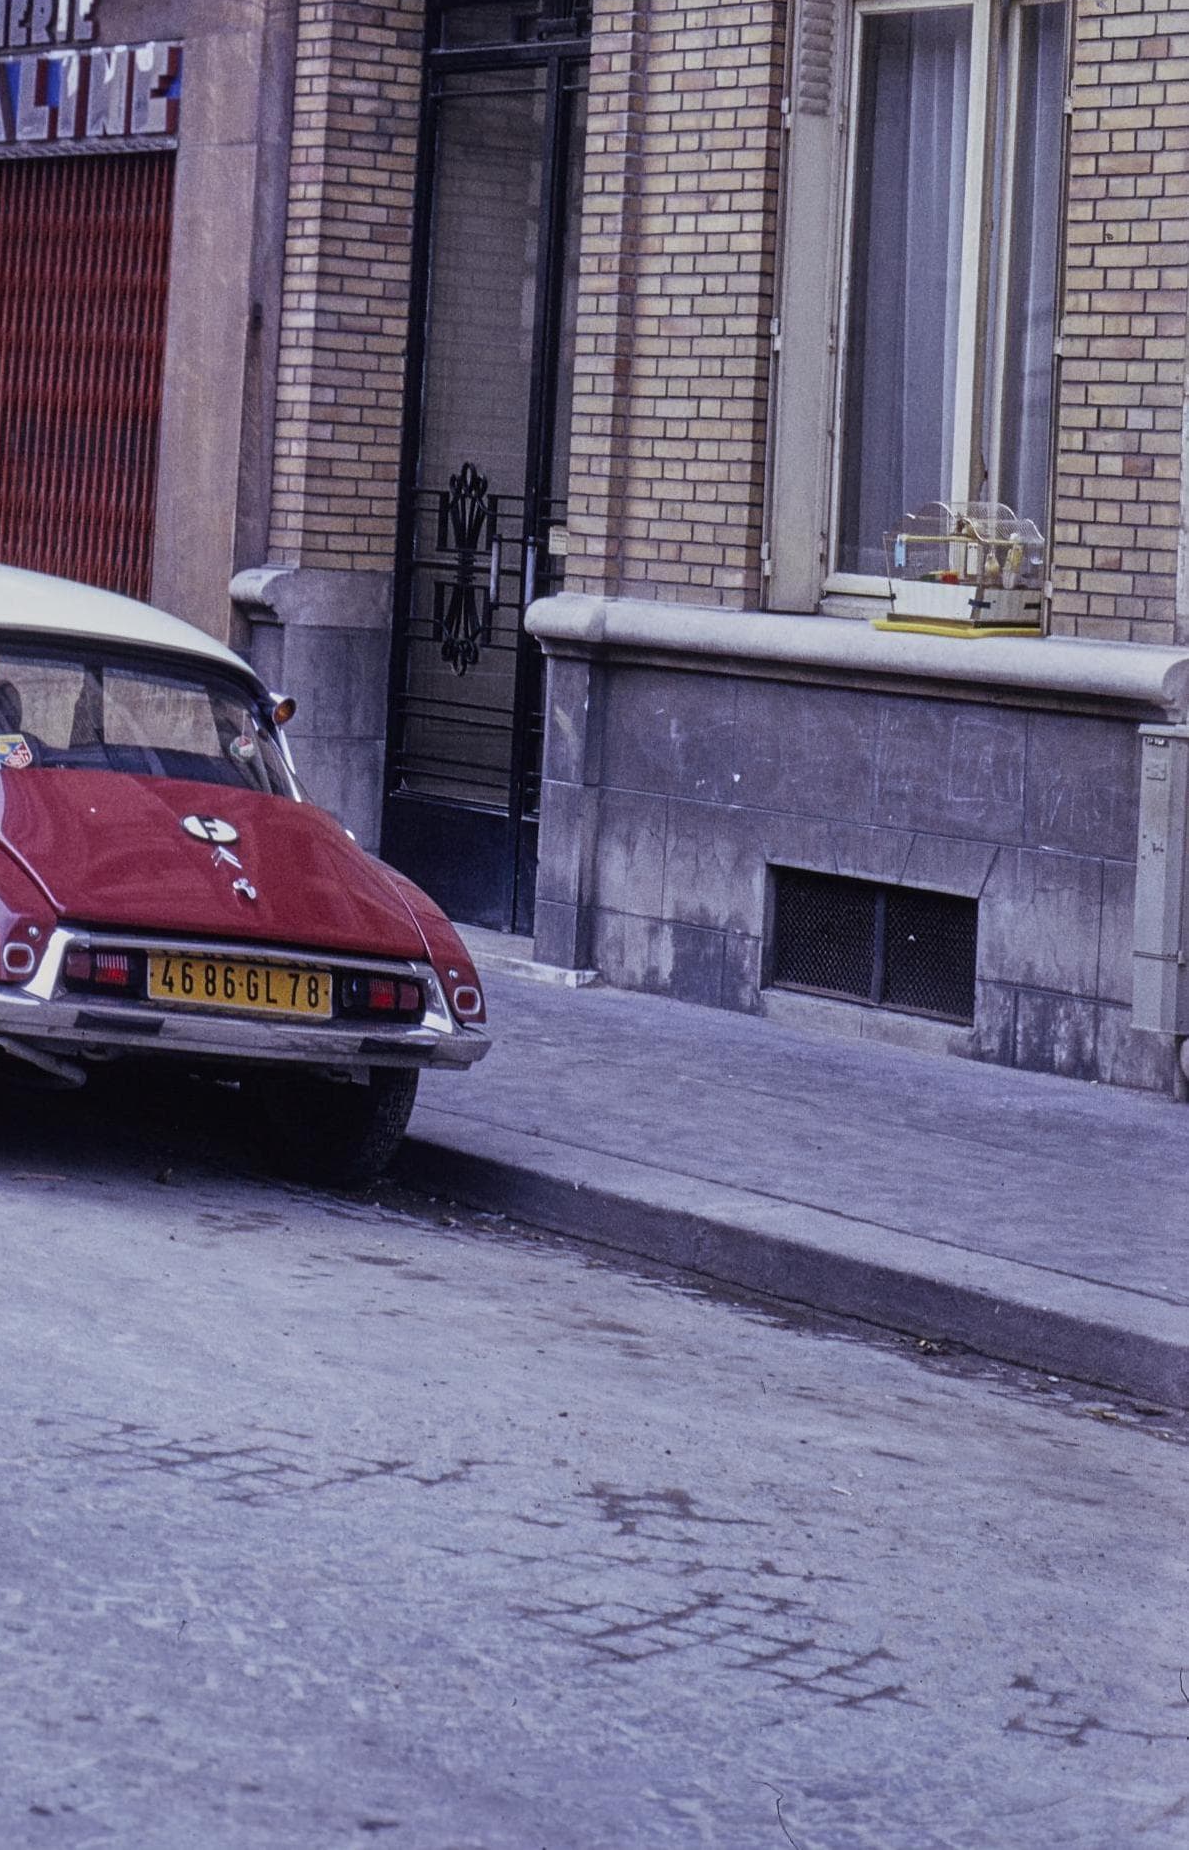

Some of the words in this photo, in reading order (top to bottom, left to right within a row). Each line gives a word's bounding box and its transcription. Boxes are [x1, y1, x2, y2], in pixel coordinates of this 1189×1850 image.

[161, 959, 236, 1000] 4686
[246, 968, 278, 1004] GL
[287, 972, 320, 1009] 78
